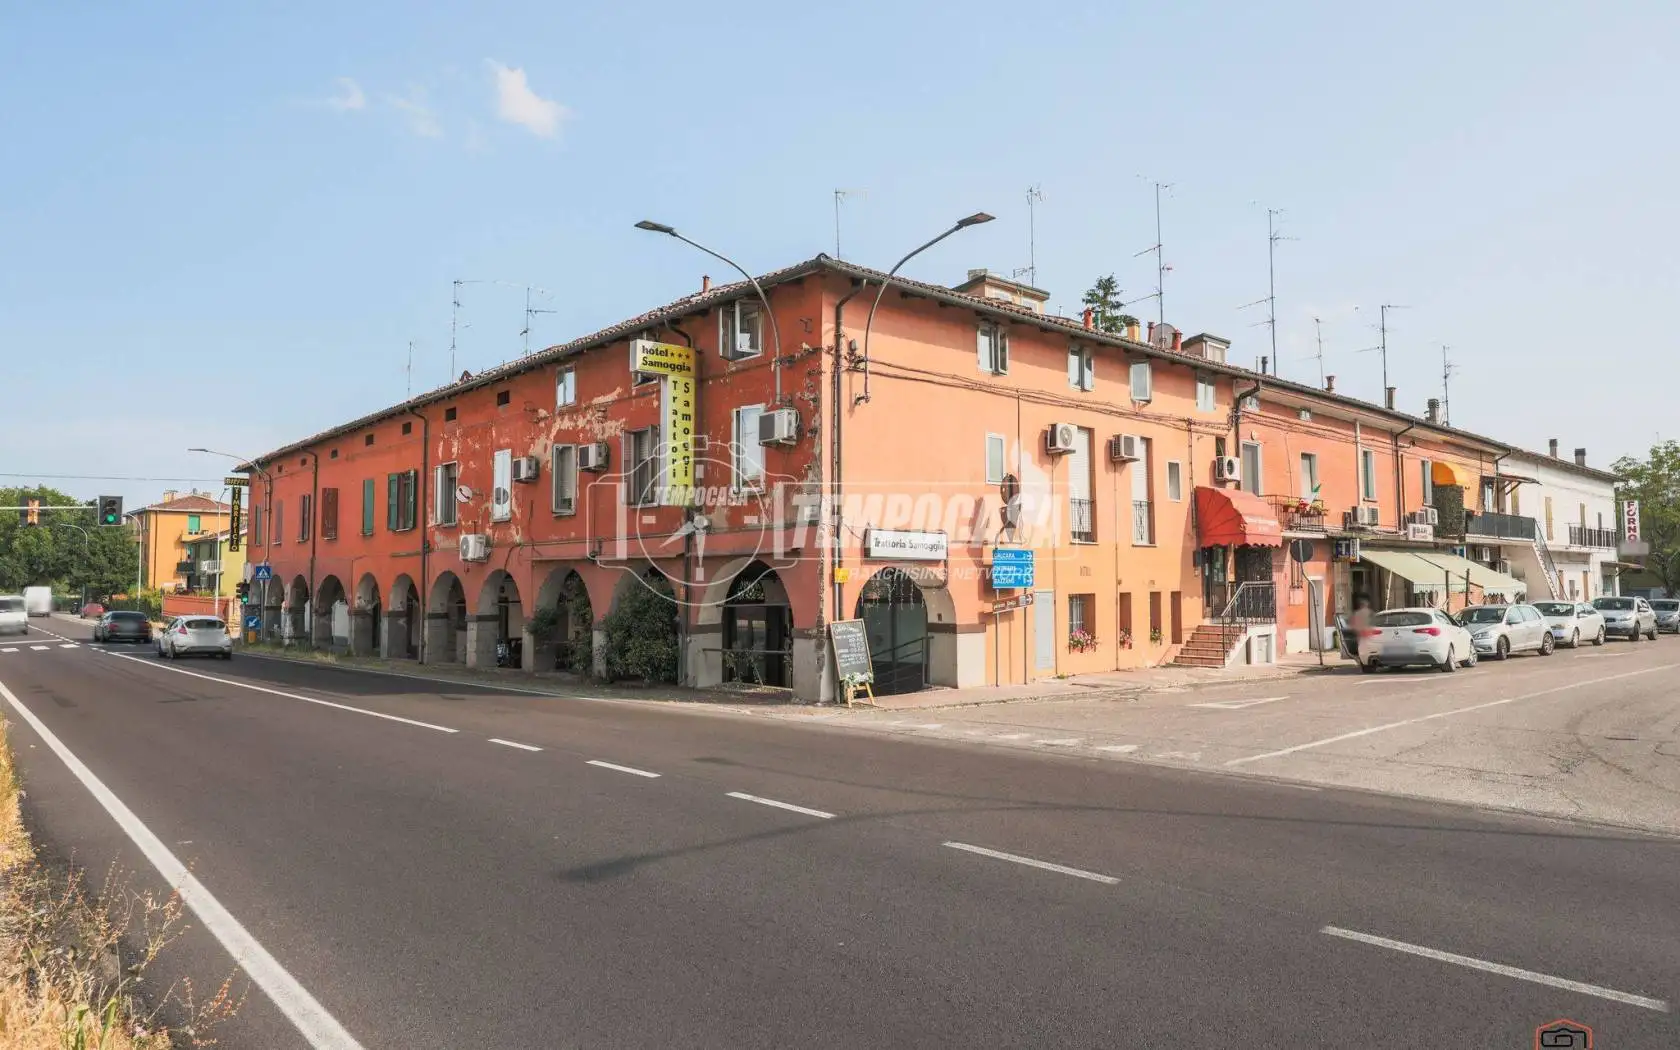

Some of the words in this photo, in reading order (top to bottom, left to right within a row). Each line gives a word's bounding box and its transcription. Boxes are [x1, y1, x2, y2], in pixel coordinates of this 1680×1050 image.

[642, 345, 669, 357] hotel
[642, 356, 691, 373] Samoggia
[671, 380, 679, 490] Trattori
[874, 537, 907, 549] Trattoria
